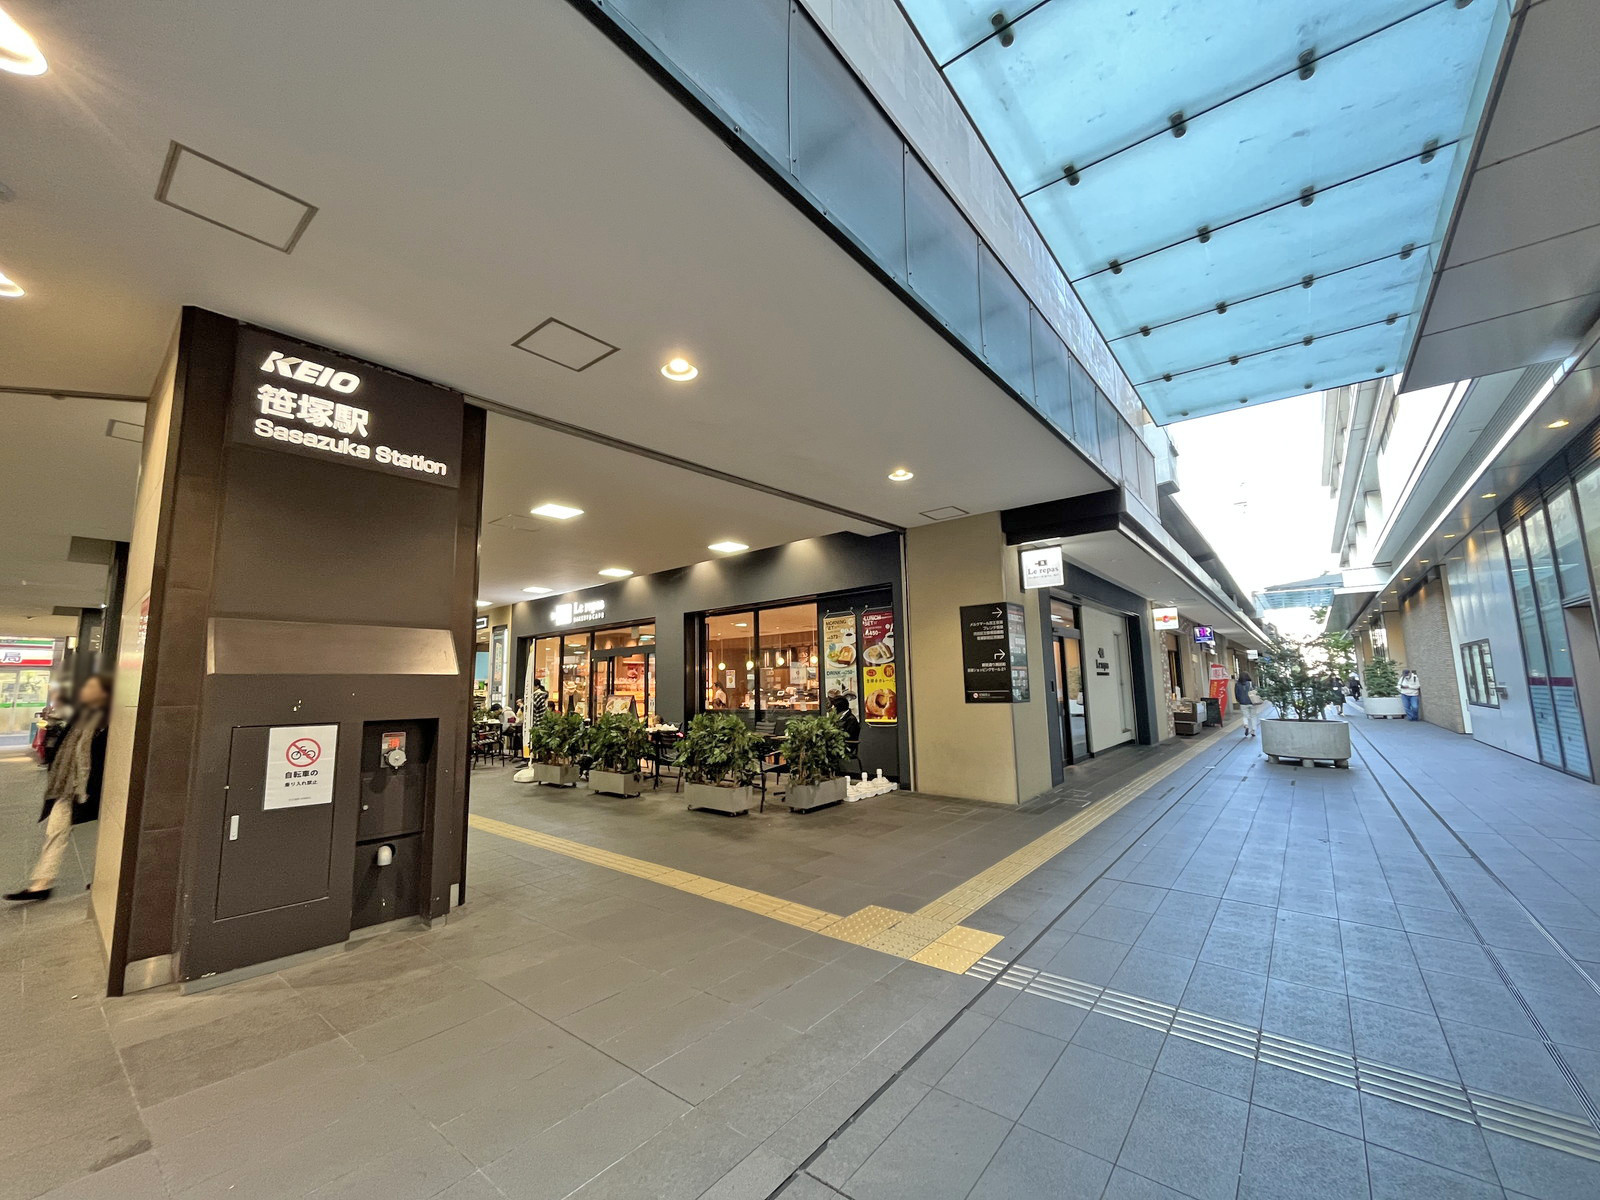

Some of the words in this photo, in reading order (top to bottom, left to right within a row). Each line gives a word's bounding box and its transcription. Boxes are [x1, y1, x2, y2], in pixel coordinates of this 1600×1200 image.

[260, 350, 361, 394] KEIO
[257, 383, 370, 438] 笹塚駅
[254, 418, 371, 459] Sasazuka
[375, 445, 447, 476] Station
[285, 770, 318, 779] 自転車の
